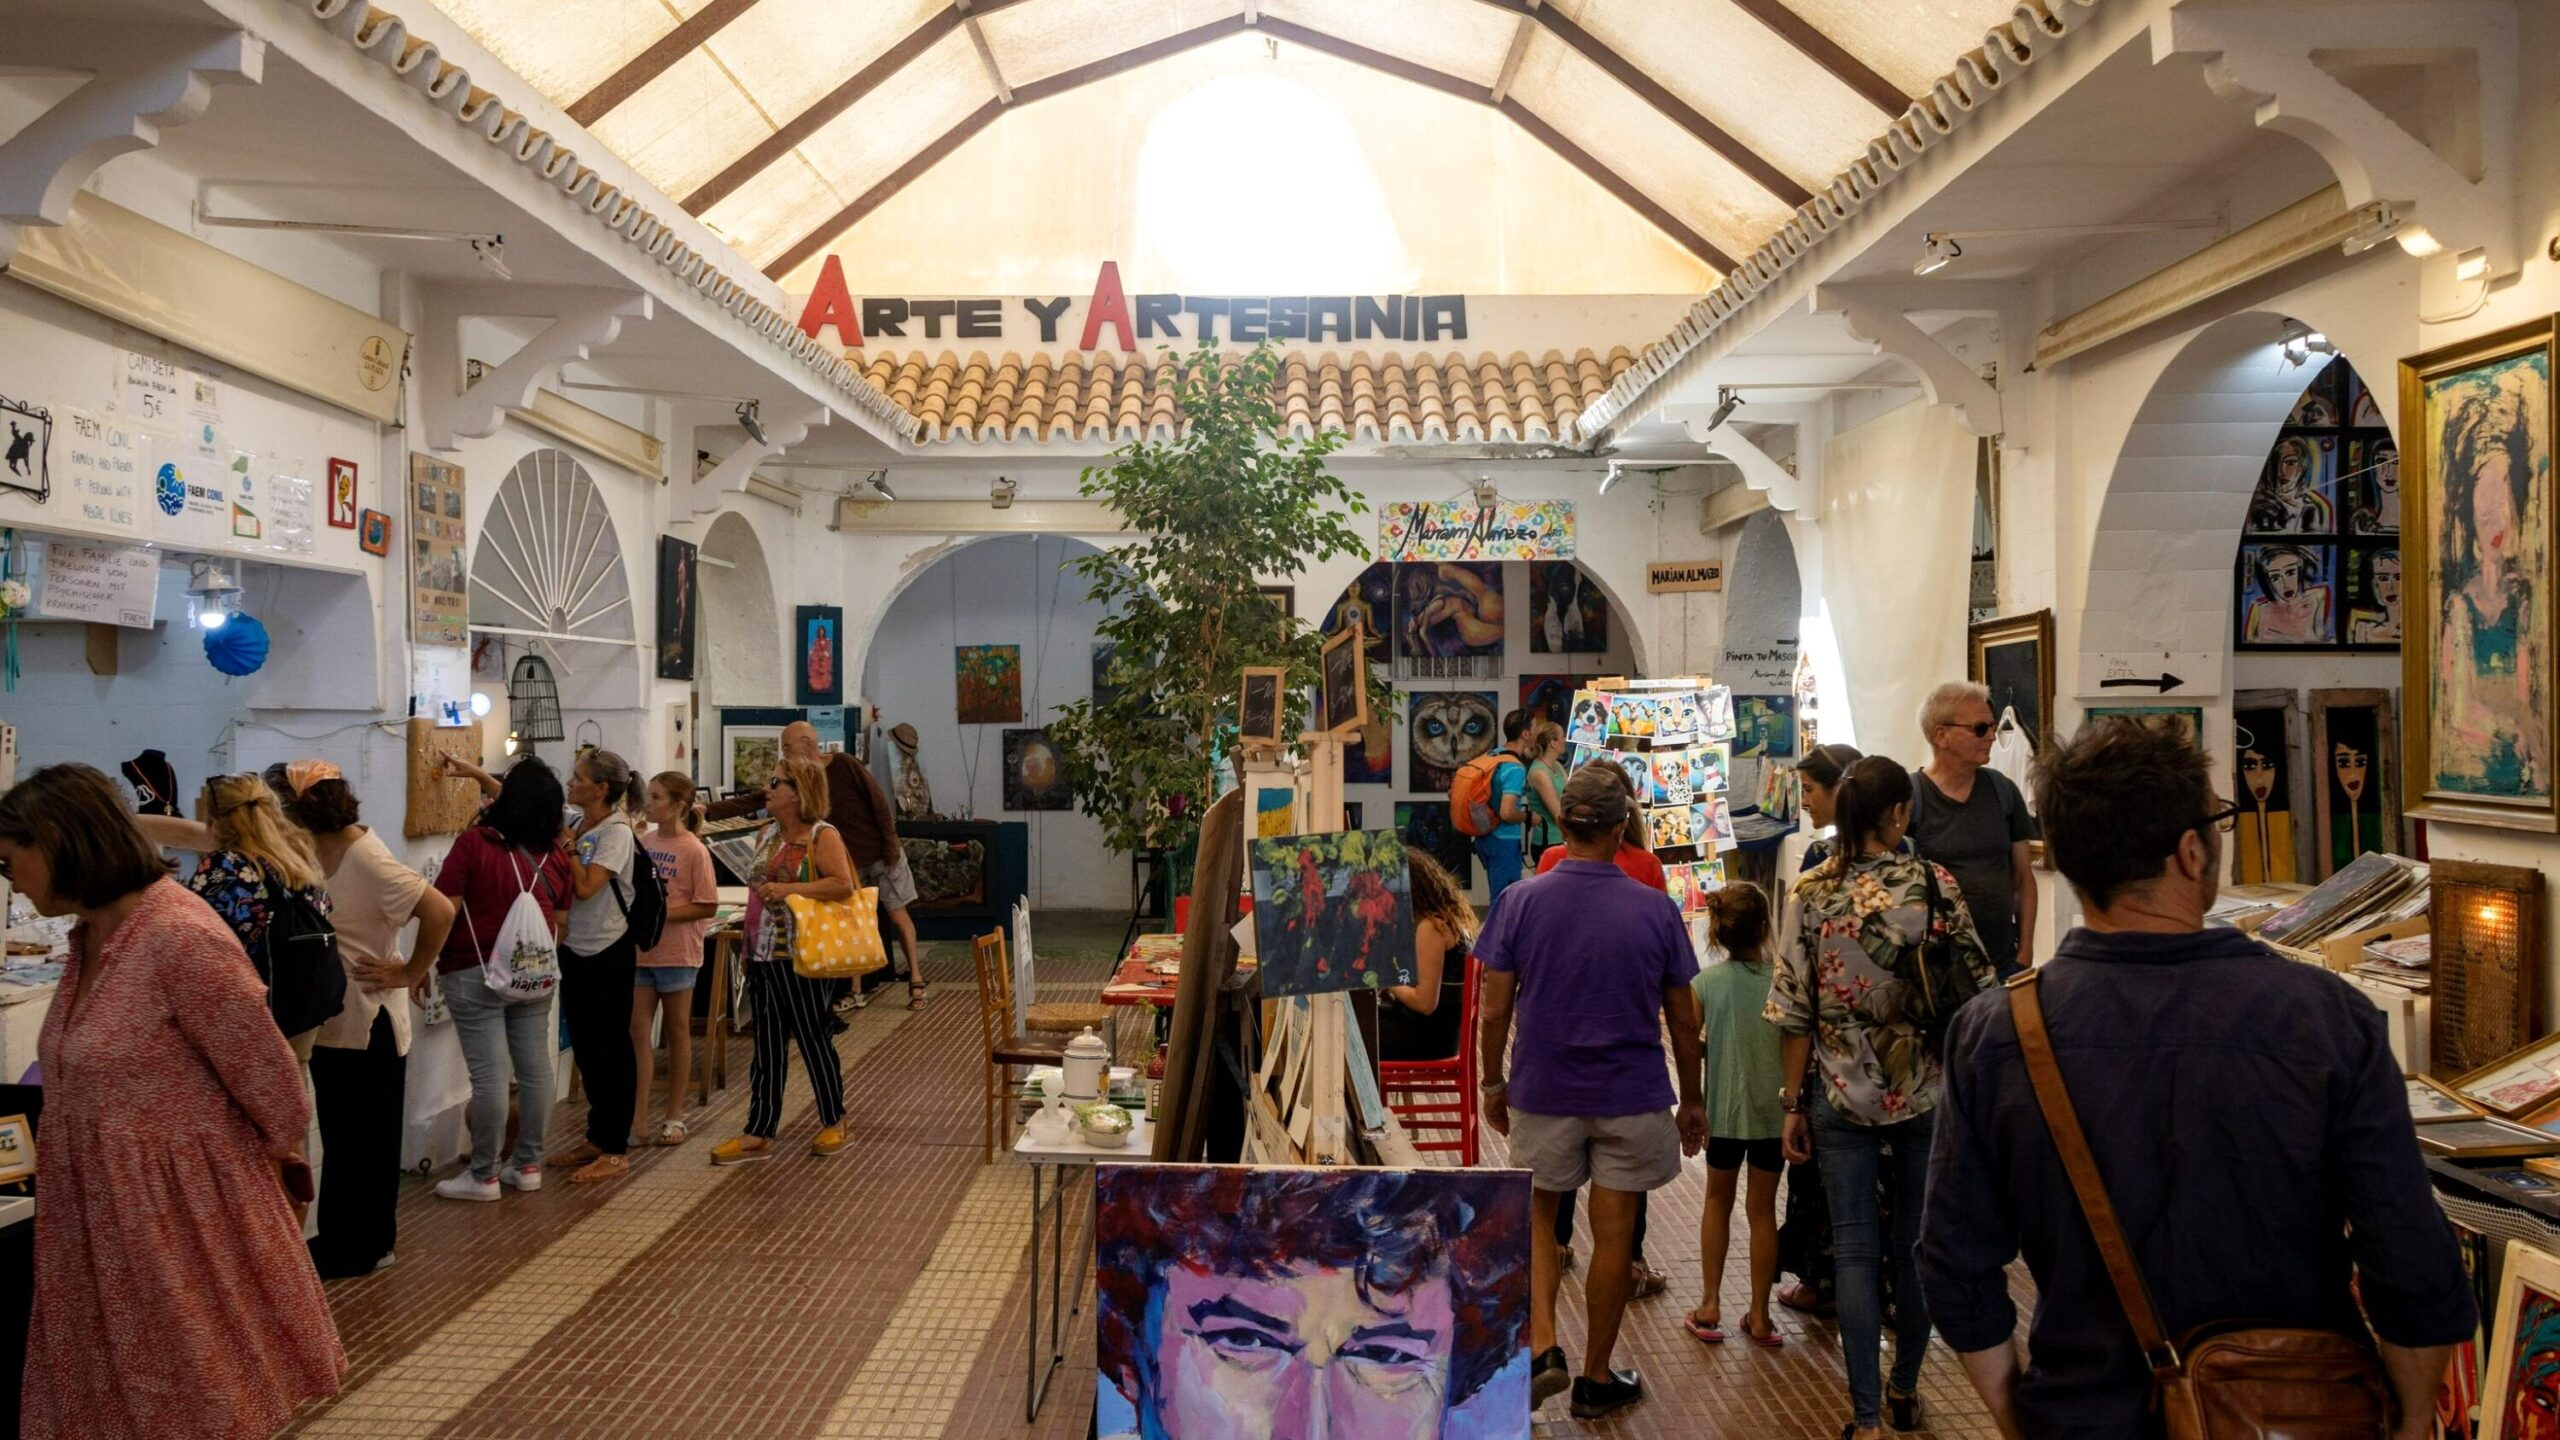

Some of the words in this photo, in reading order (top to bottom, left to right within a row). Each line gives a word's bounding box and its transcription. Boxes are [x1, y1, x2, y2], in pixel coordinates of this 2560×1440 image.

[799, 254, 1002, 347] ARTE
[1024, 296, 1071, 342] Y
[1079, 261, 1468, 352] ARTESANIA
[128, 352, 175, 378] CAMISETA
[143, 394, 163, 420] 5€
[73, 416, 102, 440] FAEM
[187, 484, 206, 499] FAEM
[51, 559, 101, 574] FREUNDE
[82, 548, 121, 567] FAMILIE
[50, 571, 100, 588] PERSONEN
[109, 582, 127, 592] MIT
[48, 584, 115, 602] PSYCHISCHER
[123, 612, 147, 623] FAEM
[1756, 652, 1768, 661] TU
